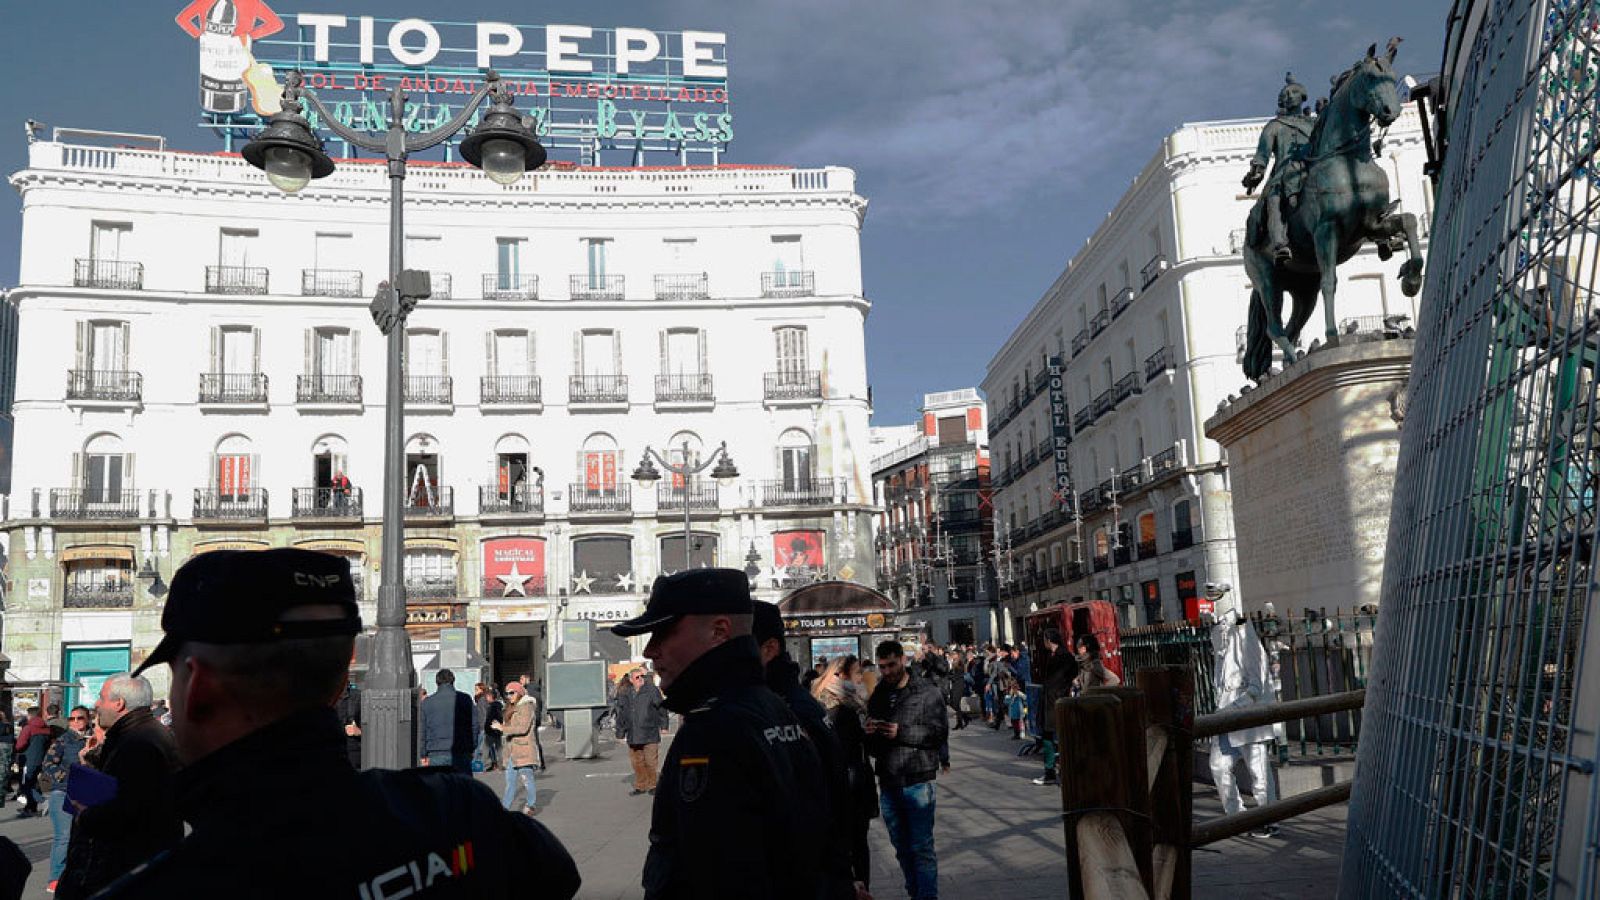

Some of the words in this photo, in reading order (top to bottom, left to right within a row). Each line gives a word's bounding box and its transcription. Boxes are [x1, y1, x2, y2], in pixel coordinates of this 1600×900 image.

[298, 14, 441, 66] TIO
[476, 21, 727, 77] PEPE
[300, 74, 345, 89] OL
[355, 75, 386, 91] DE
[400, 76, 538, 96] ANDALCIA
[549, 81, 729, 102] EMBOTELLADO
[598, 99, 734, 142] BYASS
[1050, 365, 1065, 426] HOTEL
[1056, 437, 1071, 513] EUROPA
[294, 571, 340, 588] CNP
[577, 610, 629, 620] SEPHORA
[784, 620, 799, 629] TOP
[800, 619, 826, 628] TOURS
[836, 616, 867, 626] TICKETS
